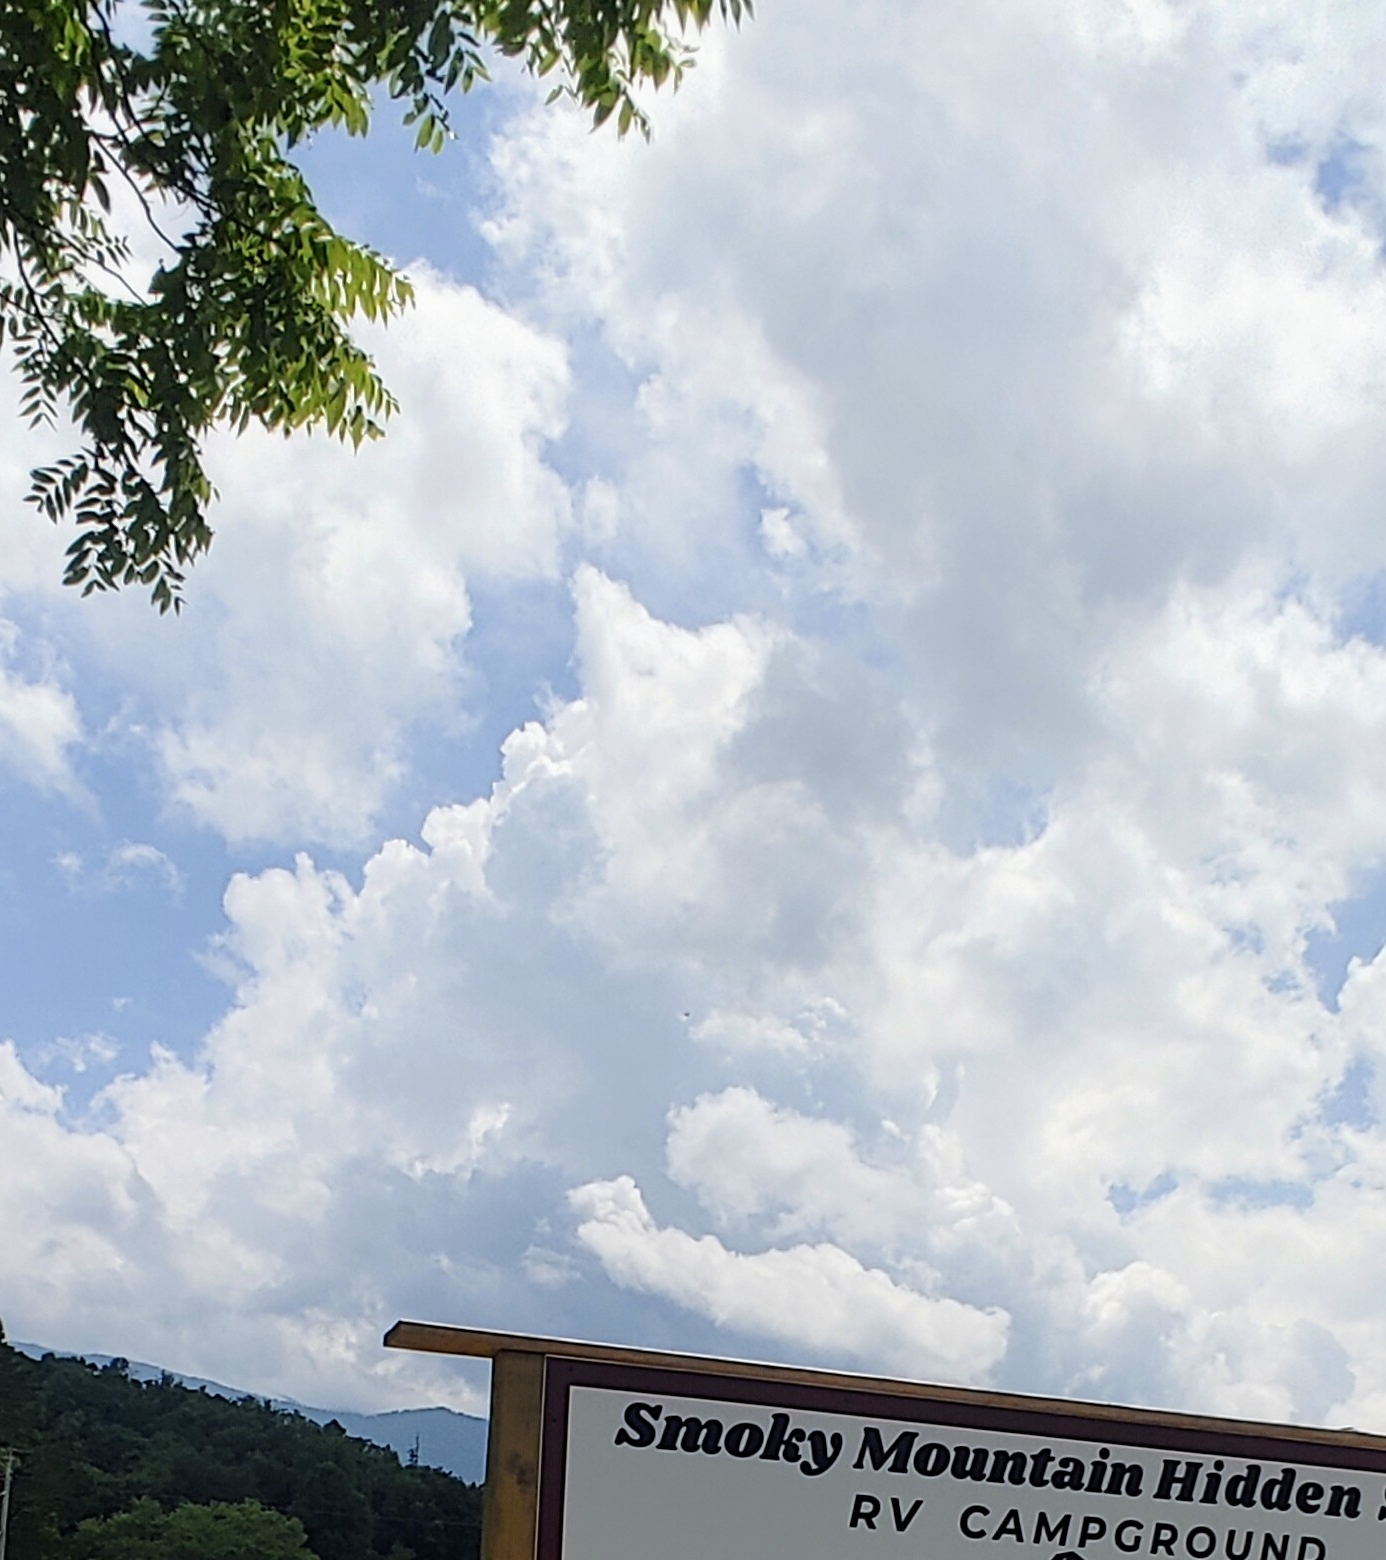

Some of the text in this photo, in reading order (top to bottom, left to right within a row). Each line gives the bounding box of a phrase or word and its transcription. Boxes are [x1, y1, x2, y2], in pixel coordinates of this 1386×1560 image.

[614, 1402, 843, 1477] Smoky
[852, 1426, 1144, 1497] Mountain
[1152, 1458, 1362, 1519] Hidden
[849, 1494, 924, 1532] RV
